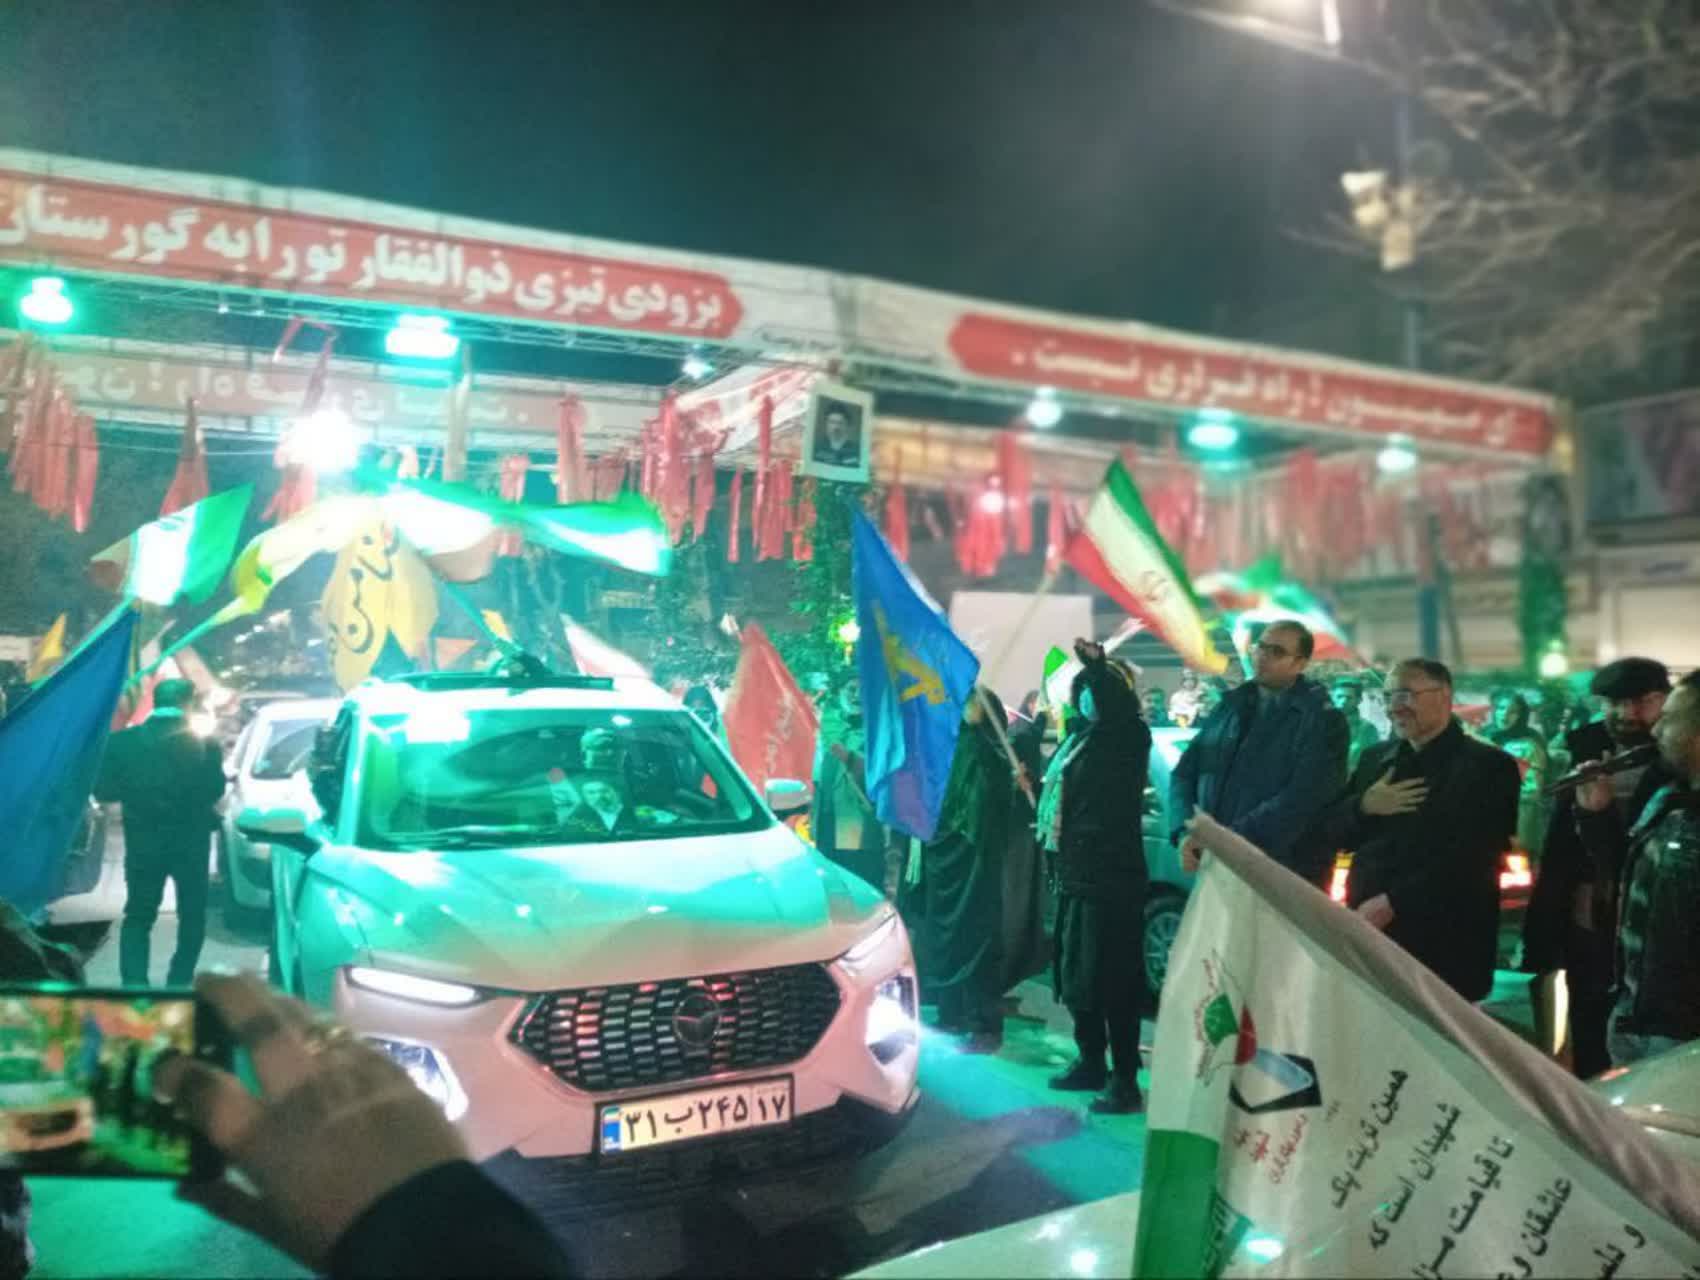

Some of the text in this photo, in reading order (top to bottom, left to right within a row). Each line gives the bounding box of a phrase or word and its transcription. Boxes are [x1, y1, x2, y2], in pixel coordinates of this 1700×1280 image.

[203, 221, 250, 273] به
[255, 216, 298, 279] را
[304, 228, 348, 283] تو
[352, 233, 512, 306] ذوالفقار
[514, 266, 607, 317] تیزی
[608, 280, 723, 328] بزودی
[1371, 1069, 1409, 1125] همین
[1487, 1135, 1515, 1159] تا
[1331, 1171, 1363, 1209] پاک
[1368, 1102, 1461, 1250] شهیدان است که
[1448, 1153, 1503, 1234] قیامت
[1520, 1177, 1573, 1257] عاشقان
[1623, 1223, 1646, 1249] و
